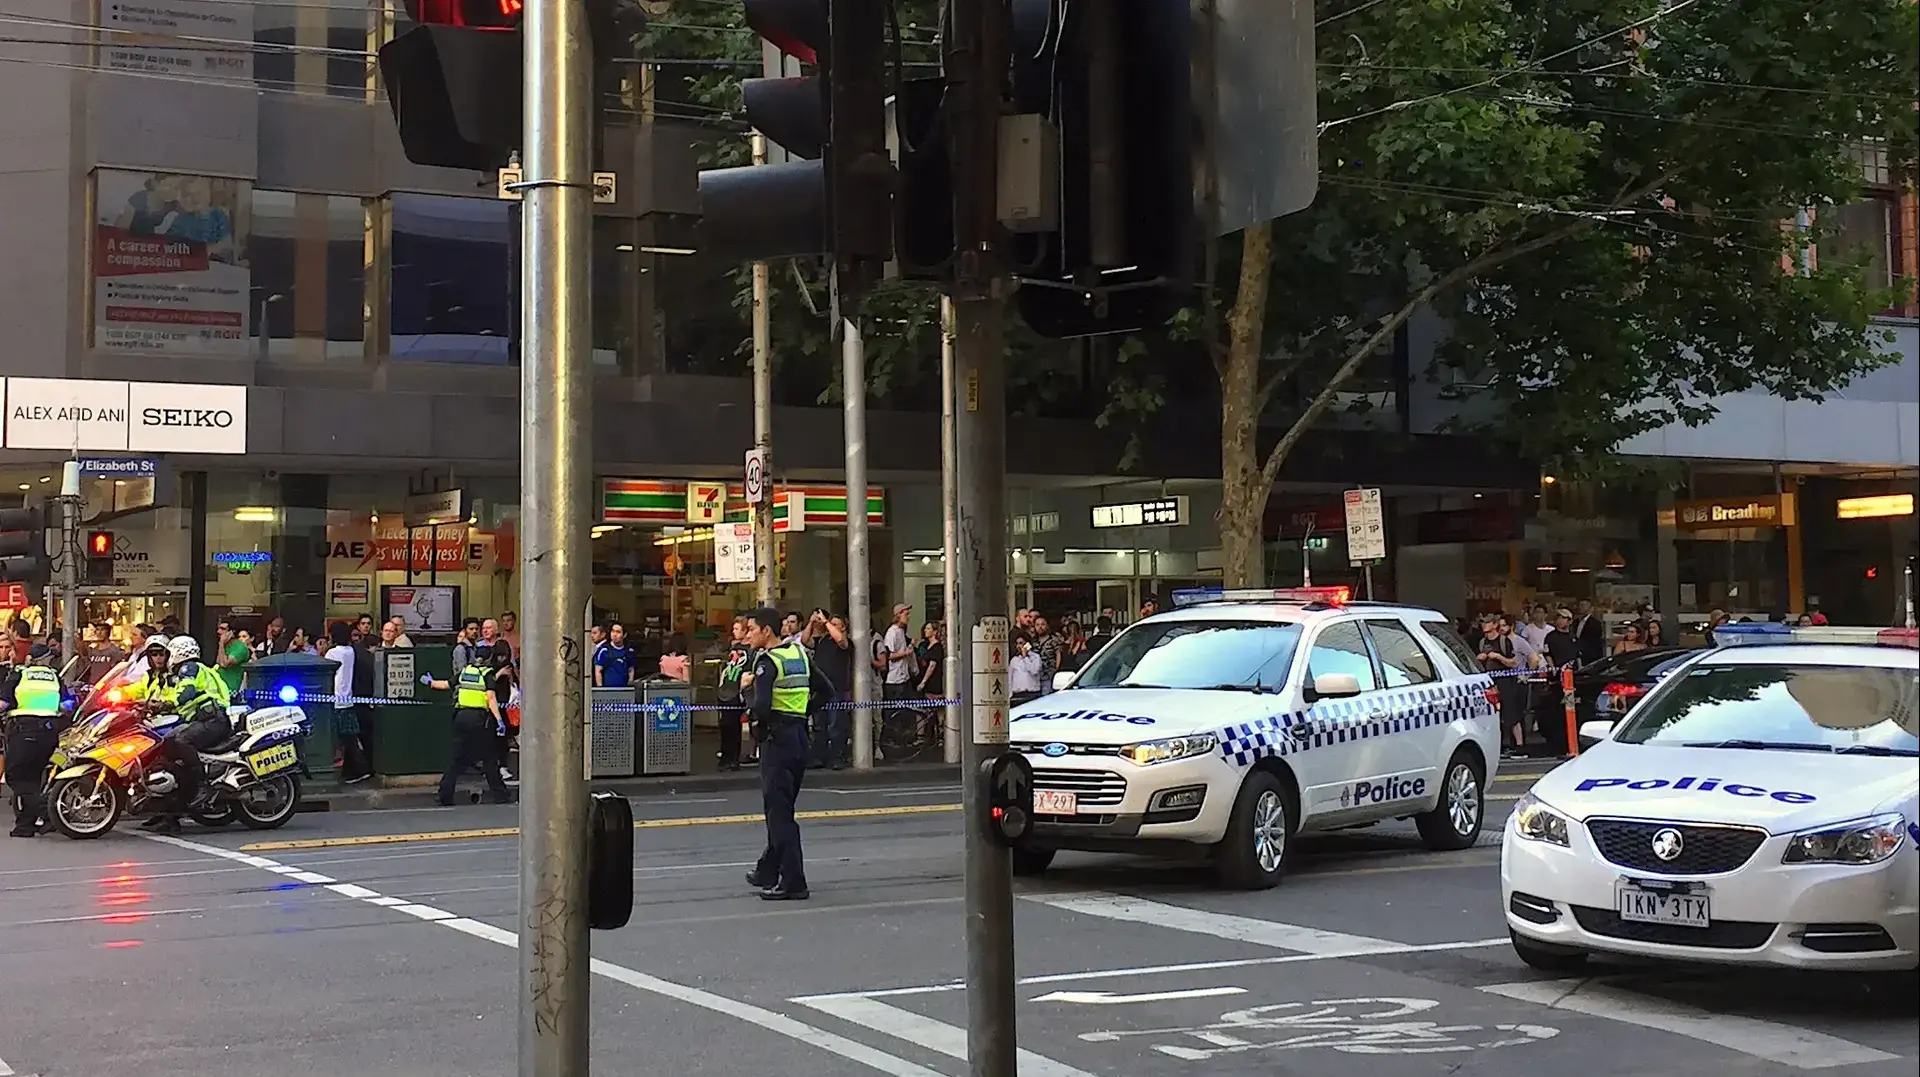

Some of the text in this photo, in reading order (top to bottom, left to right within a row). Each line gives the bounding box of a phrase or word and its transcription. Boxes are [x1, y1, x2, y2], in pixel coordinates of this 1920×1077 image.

[107, 238, 191, 254] A career with
[107, 254, 182, 268] compassion
[14, 405, 53, 421] ALEX
[97, 408, 125, 423] ANI
[143, 408, 233, 429] SEIKO
[86, 460, 155, 473] Elizabeth St
[748, 467, 760, 488] 40
[698, 487, 719, 517] 7
[1350, 526, 1362, 535] 1P
[1368, 524, 1380, 533] 1P
[391, 544, 418, 561] wih
[721, 544, 730, 556] S
[738, 543, 751, 554] 1P
[112, 552, 149, 562] own
[1010, 710, 1156, 725] police
[256, 749, 293, 768] POLICE
[1354, 776, 1425, 805] Police
[1574, 777, 1817, 804] police
[1054, 796, 1074, 810] 297
[1626, 894, 1706, 920] 1KN 3TX
